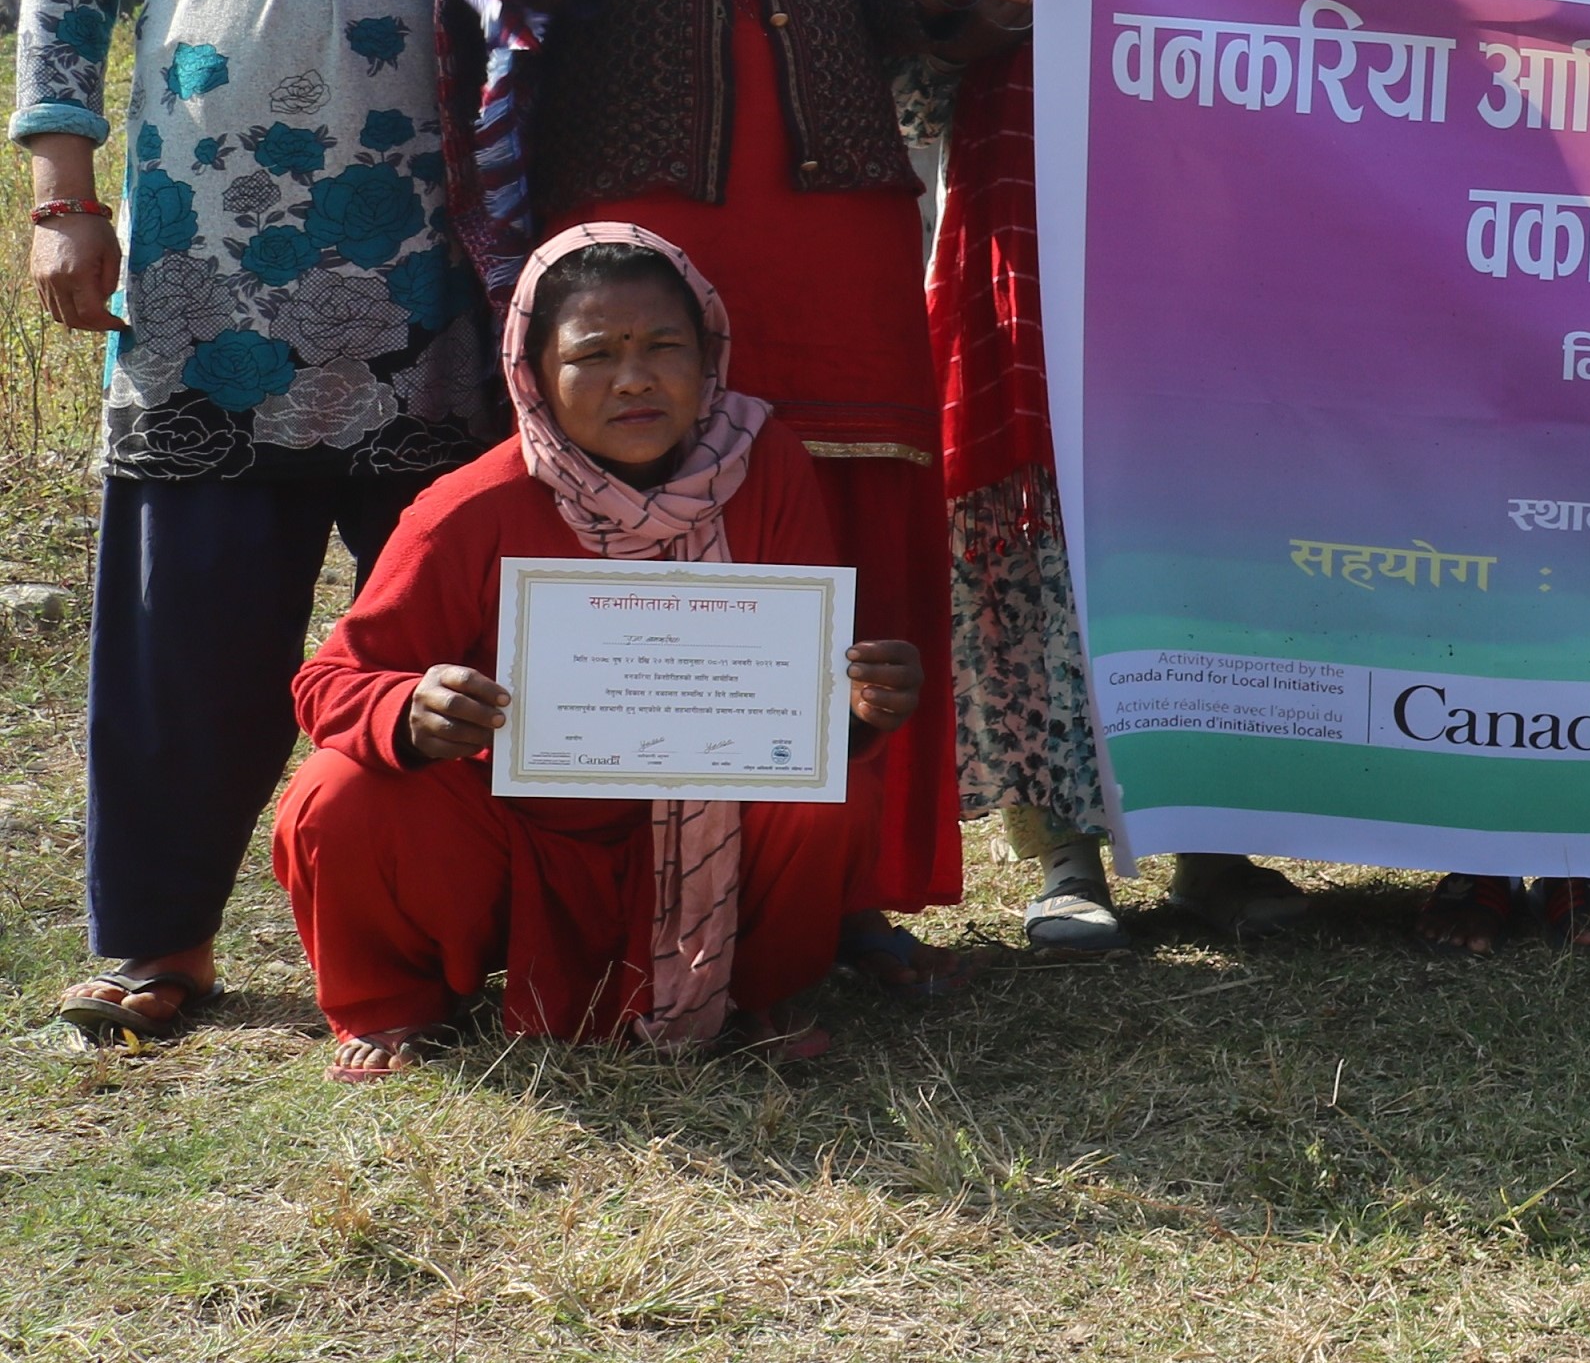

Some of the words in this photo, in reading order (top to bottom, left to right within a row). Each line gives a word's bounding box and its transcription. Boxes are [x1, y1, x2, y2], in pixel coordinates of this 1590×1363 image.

[1289, 536, 1498, 592] सहयोग
[589, 593, 680, 612] सहभागिताको
[689, 598, 758, 613] प्रमाण-पत्र
[1158, 652, 1214, 669] Activity
[1218, 656, 1294, 676] supported
[1299, 662, 1317, 677] by
[1320, 663, 1345, 678] the
[1109, 669, 1162, 685] Canada
[1167, 668, 1203, 683] Fund
[1208, 670, 1228, 685] for
[1231, 673, 1269, 689] Local
[1274, 677, 1344, 695] Initiatives
[1116, 697, 1170, 715] Activité
[1173, 698, 1230, 713] réalisée
[1233, 703, 1266, 716] avec
[1324, 710, 1343, 723] du
[1103, 718, 1131, 735] onds
[1134, 715, 1202, 729] canadien
[1293, 720, 1343, 740] locales
[578, 753, 620, 765] Canada
